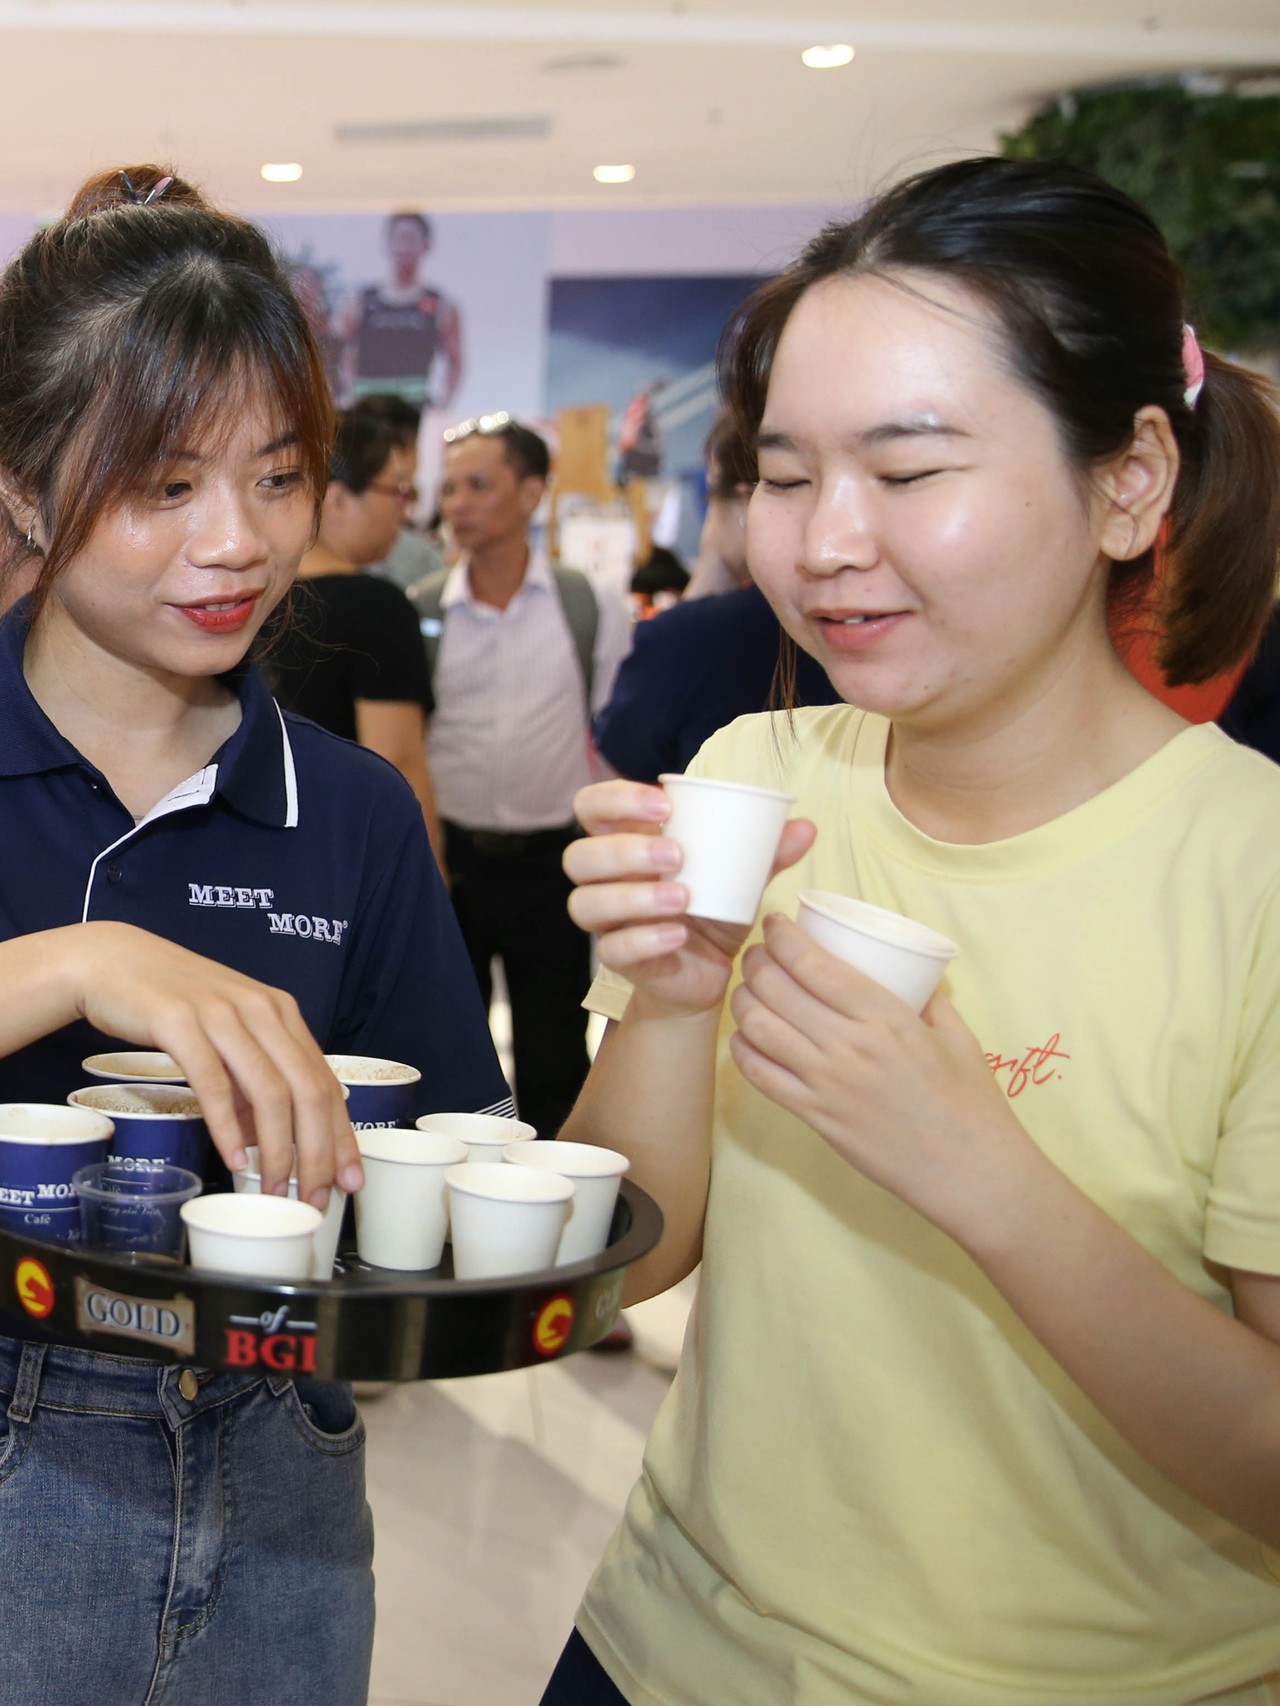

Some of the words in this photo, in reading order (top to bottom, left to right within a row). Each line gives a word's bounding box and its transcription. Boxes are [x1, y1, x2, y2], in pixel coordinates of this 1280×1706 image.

[188, 883, 274, 908] MEET
[267, 913, 344, 945] MORE
[107, 1155, 166, 1173] MORE
[24, 1213, 51, 1226] Café
[87, 1292, 181, 1337] GOLD
[261, 1305, 289, 1335] of
[225, 1329, 317, 1372] BGI
